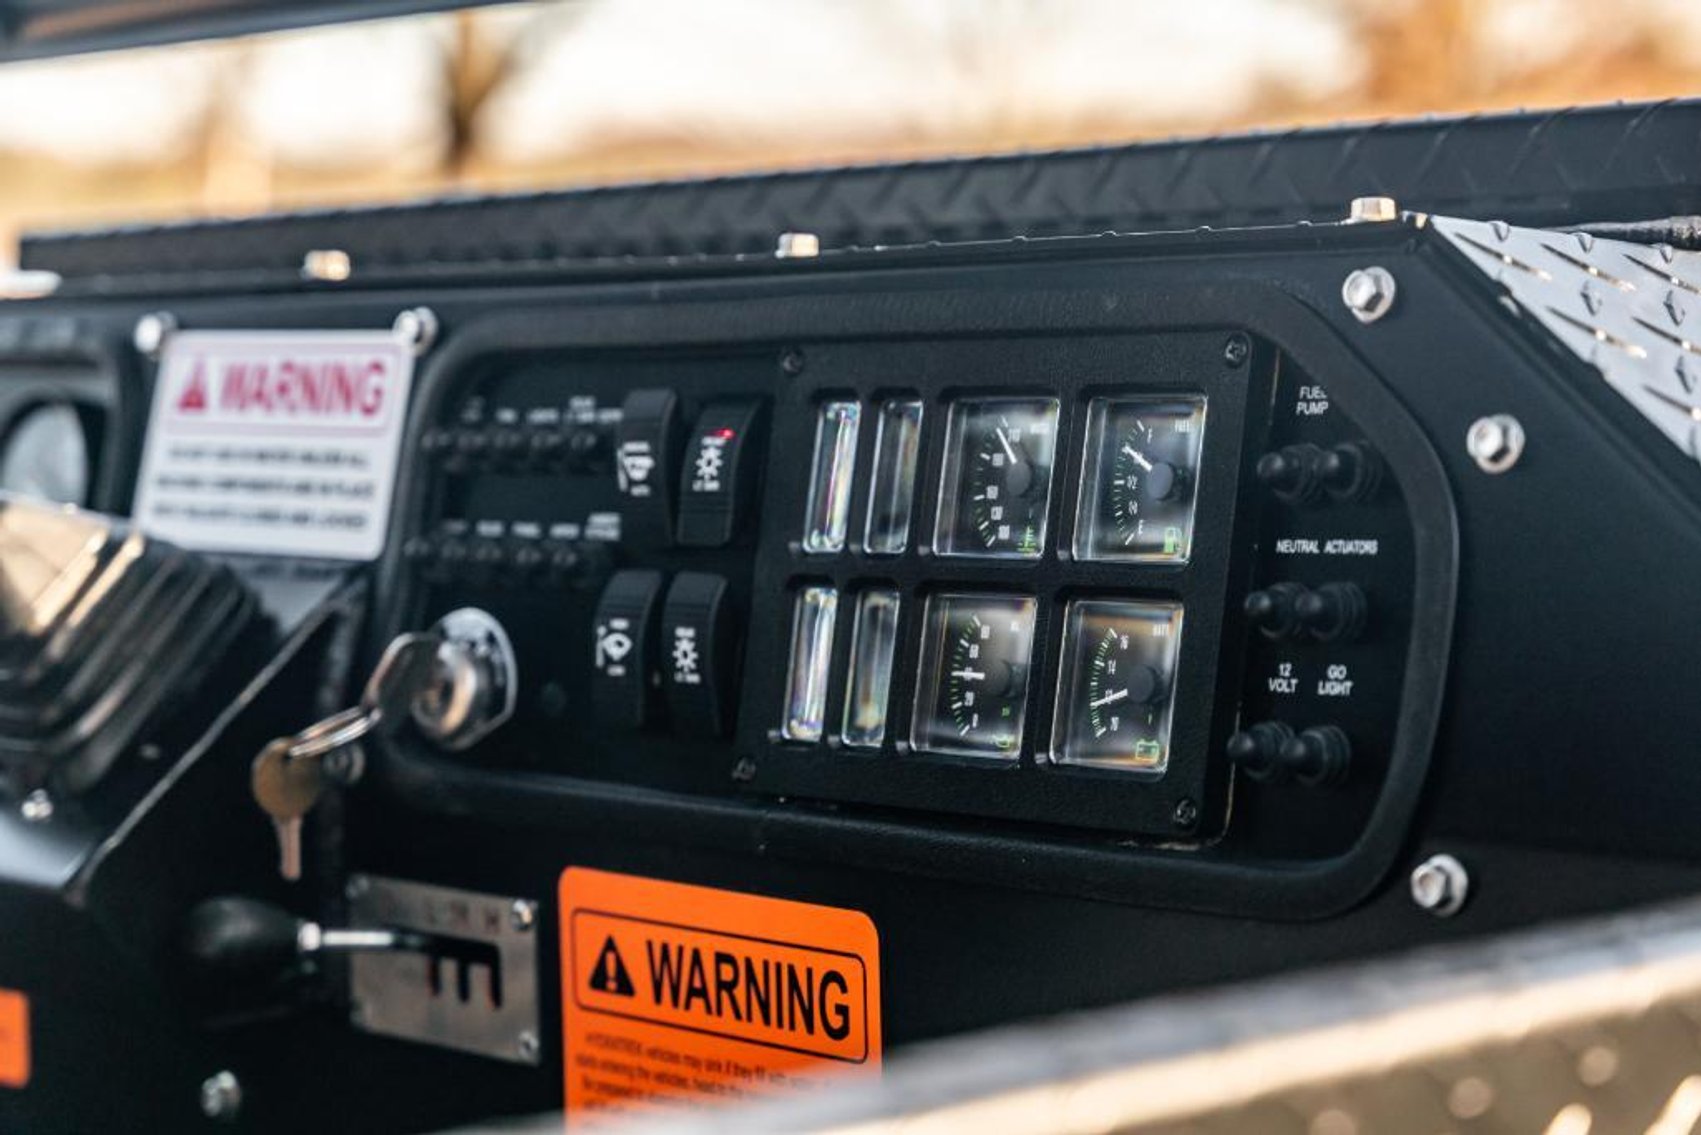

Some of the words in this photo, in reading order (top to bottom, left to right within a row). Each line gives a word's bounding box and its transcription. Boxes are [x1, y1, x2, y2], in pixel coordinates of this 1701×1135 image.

[219, 358, 386, 418] WARNING
[1296, 401, 1329, 416] PUMP
[1276, 539, 1320, 554] NEUTRAL
[1324, 540, 1378, 555] ACTUATORS
[1278, 662, 1292, 677] 12
[1327, 665, 1347, 680] GO
[1268, 678, 1299, 693] VOLT
[1317, 681, 1353, 696] LIGHT
[645, 938, 851, 1042] WARNING
